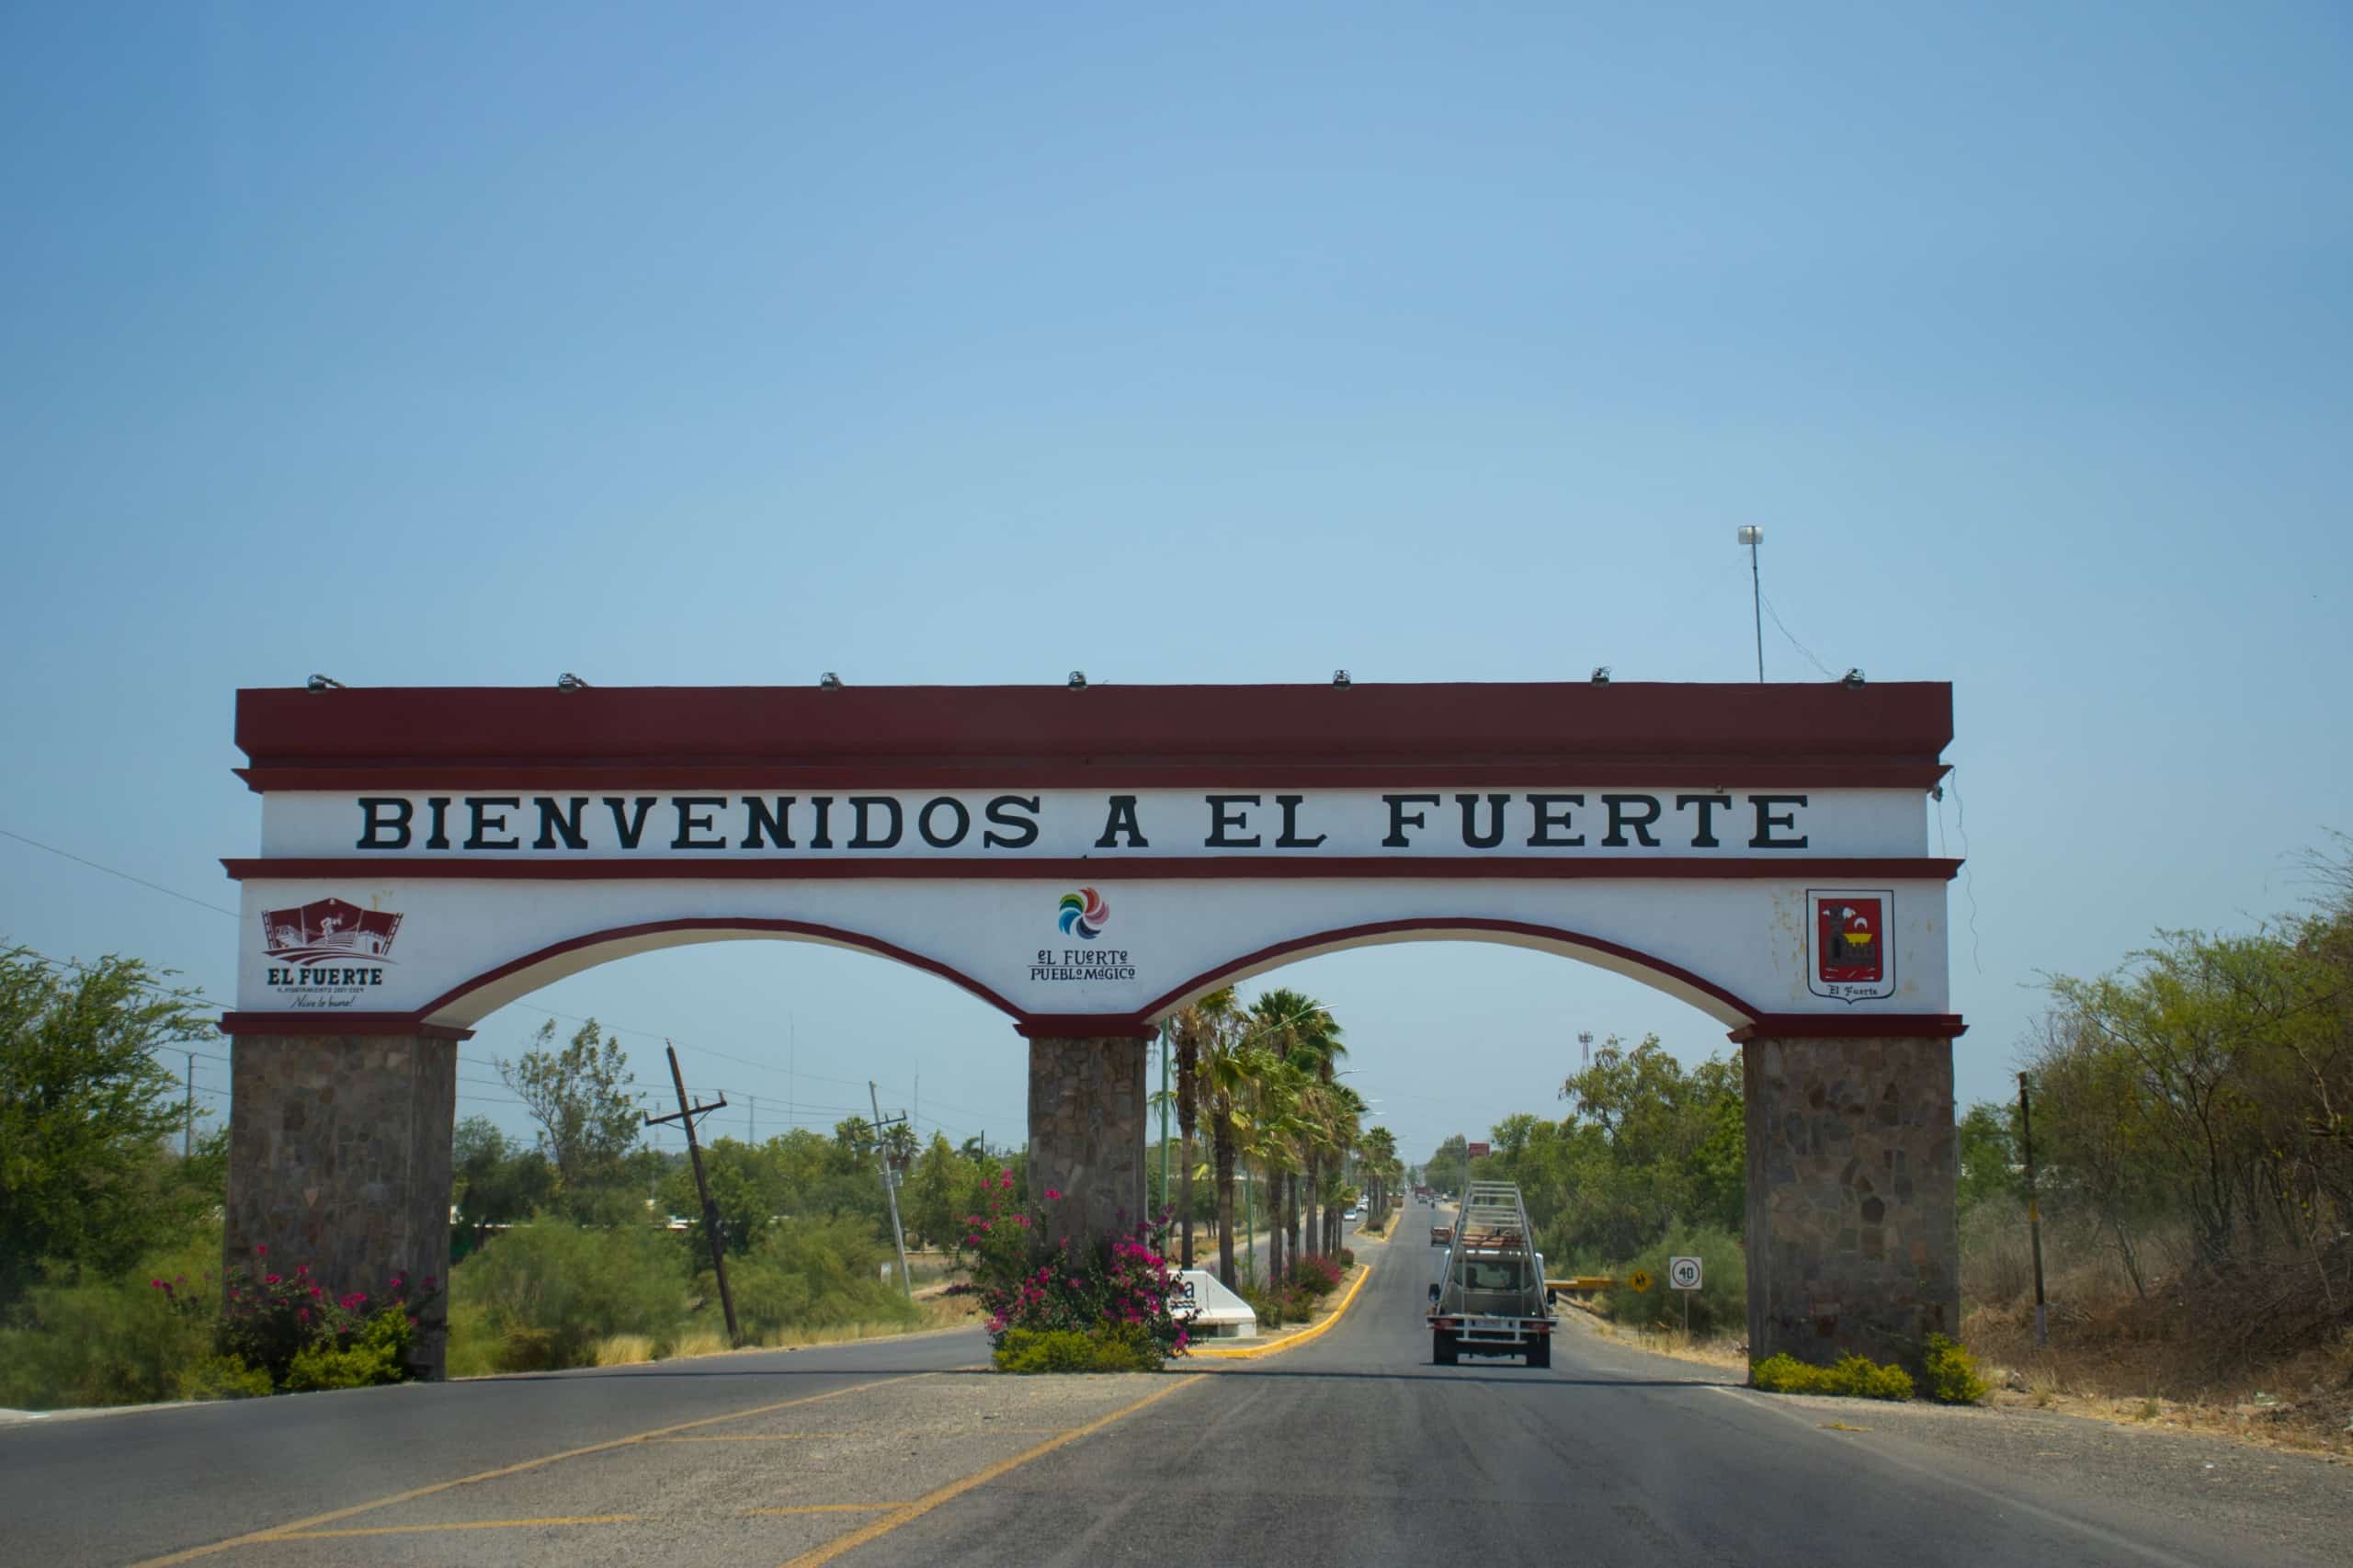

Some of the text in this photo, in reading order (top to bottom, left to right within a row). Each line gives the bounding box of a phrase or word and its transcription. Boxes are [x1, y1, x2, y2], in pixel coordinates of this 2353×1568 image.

[358, 794, 1808, 848] BIENVENIDOS A EL FUERTE
[267, 969, 382, 986] EL FUERTE
[1826, 984, 1878, 996] El Fuerte
[1679, 1267, 1694, 1279] 40
